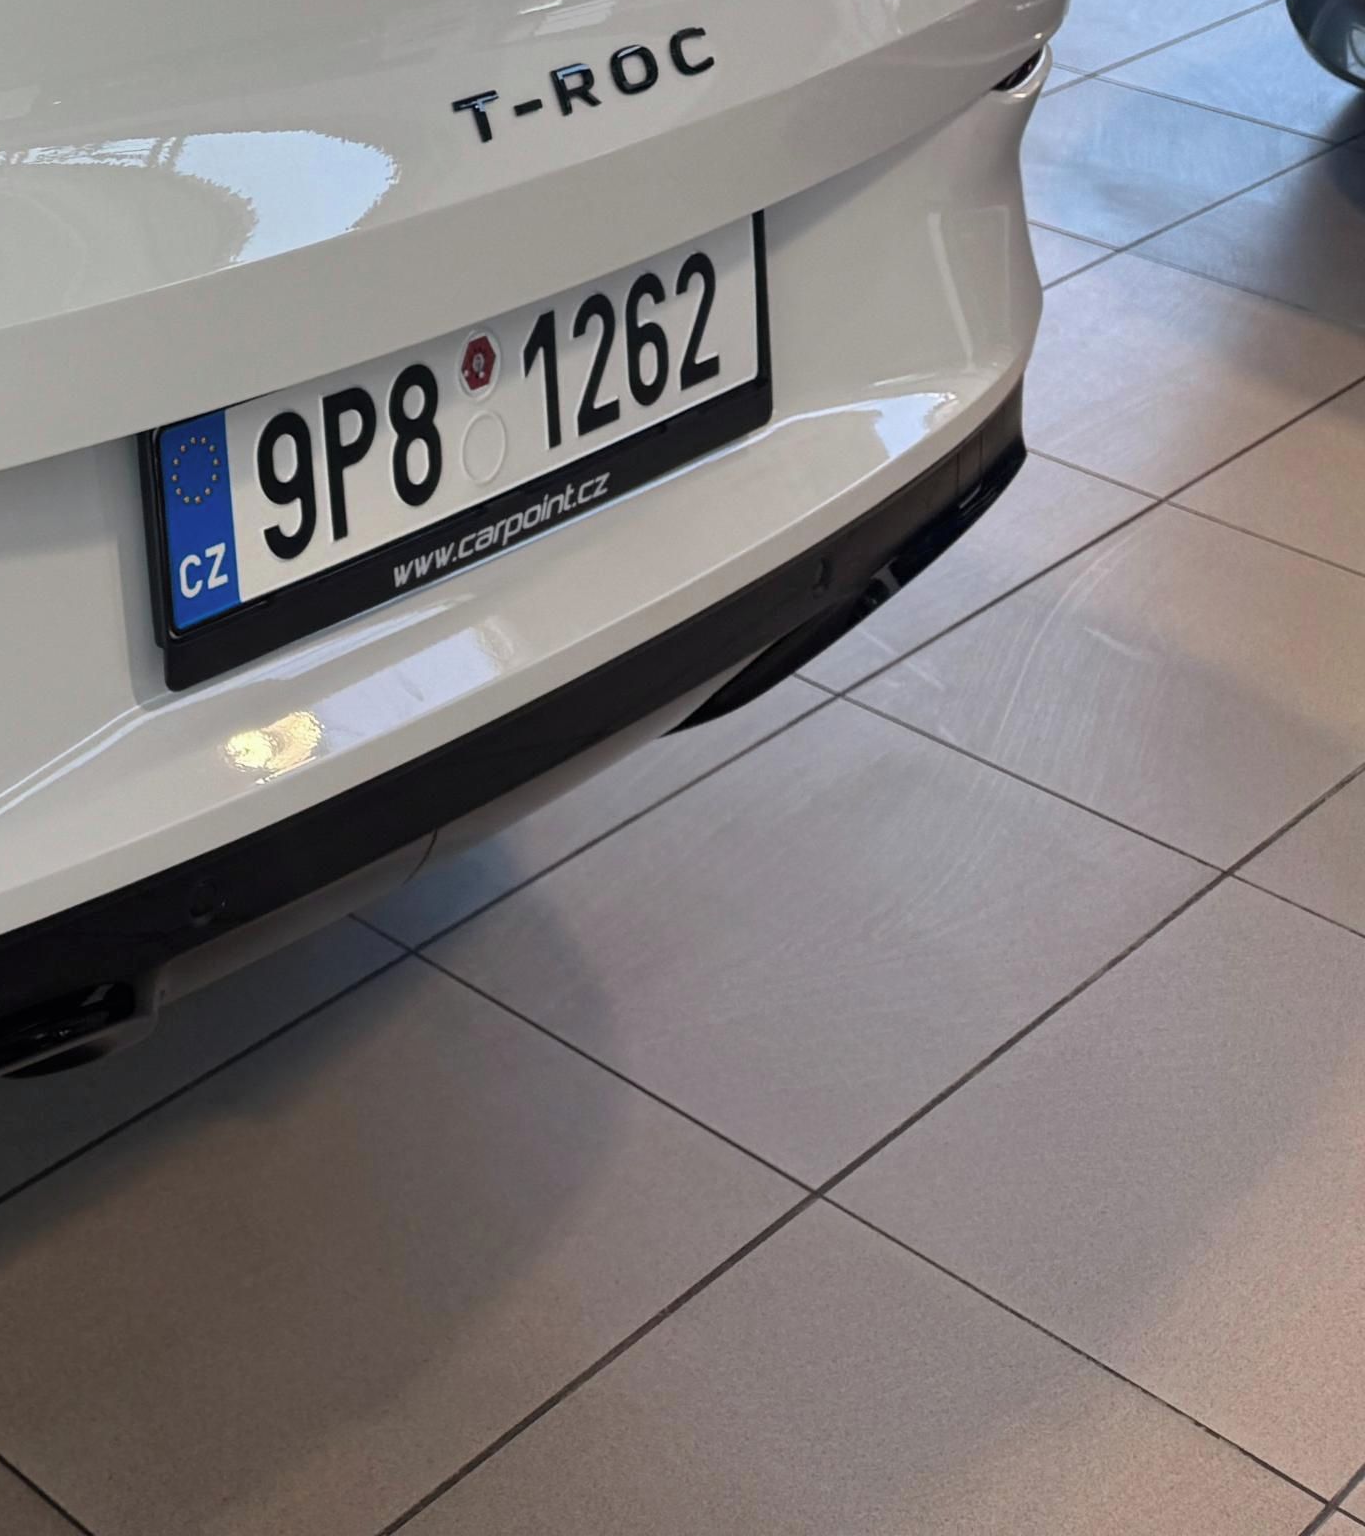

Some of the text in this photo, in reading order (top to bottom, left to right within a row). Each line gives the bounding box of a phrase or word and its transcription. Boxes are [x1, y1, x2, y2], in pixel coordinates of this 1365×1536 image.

[452, 26, 716, 143] T-ROC
[255, 252, 721, 561] 9P8 1262
[177, 541, 229, 599] CZ
[392, 469, 611, 590] www.carpoint.cz
